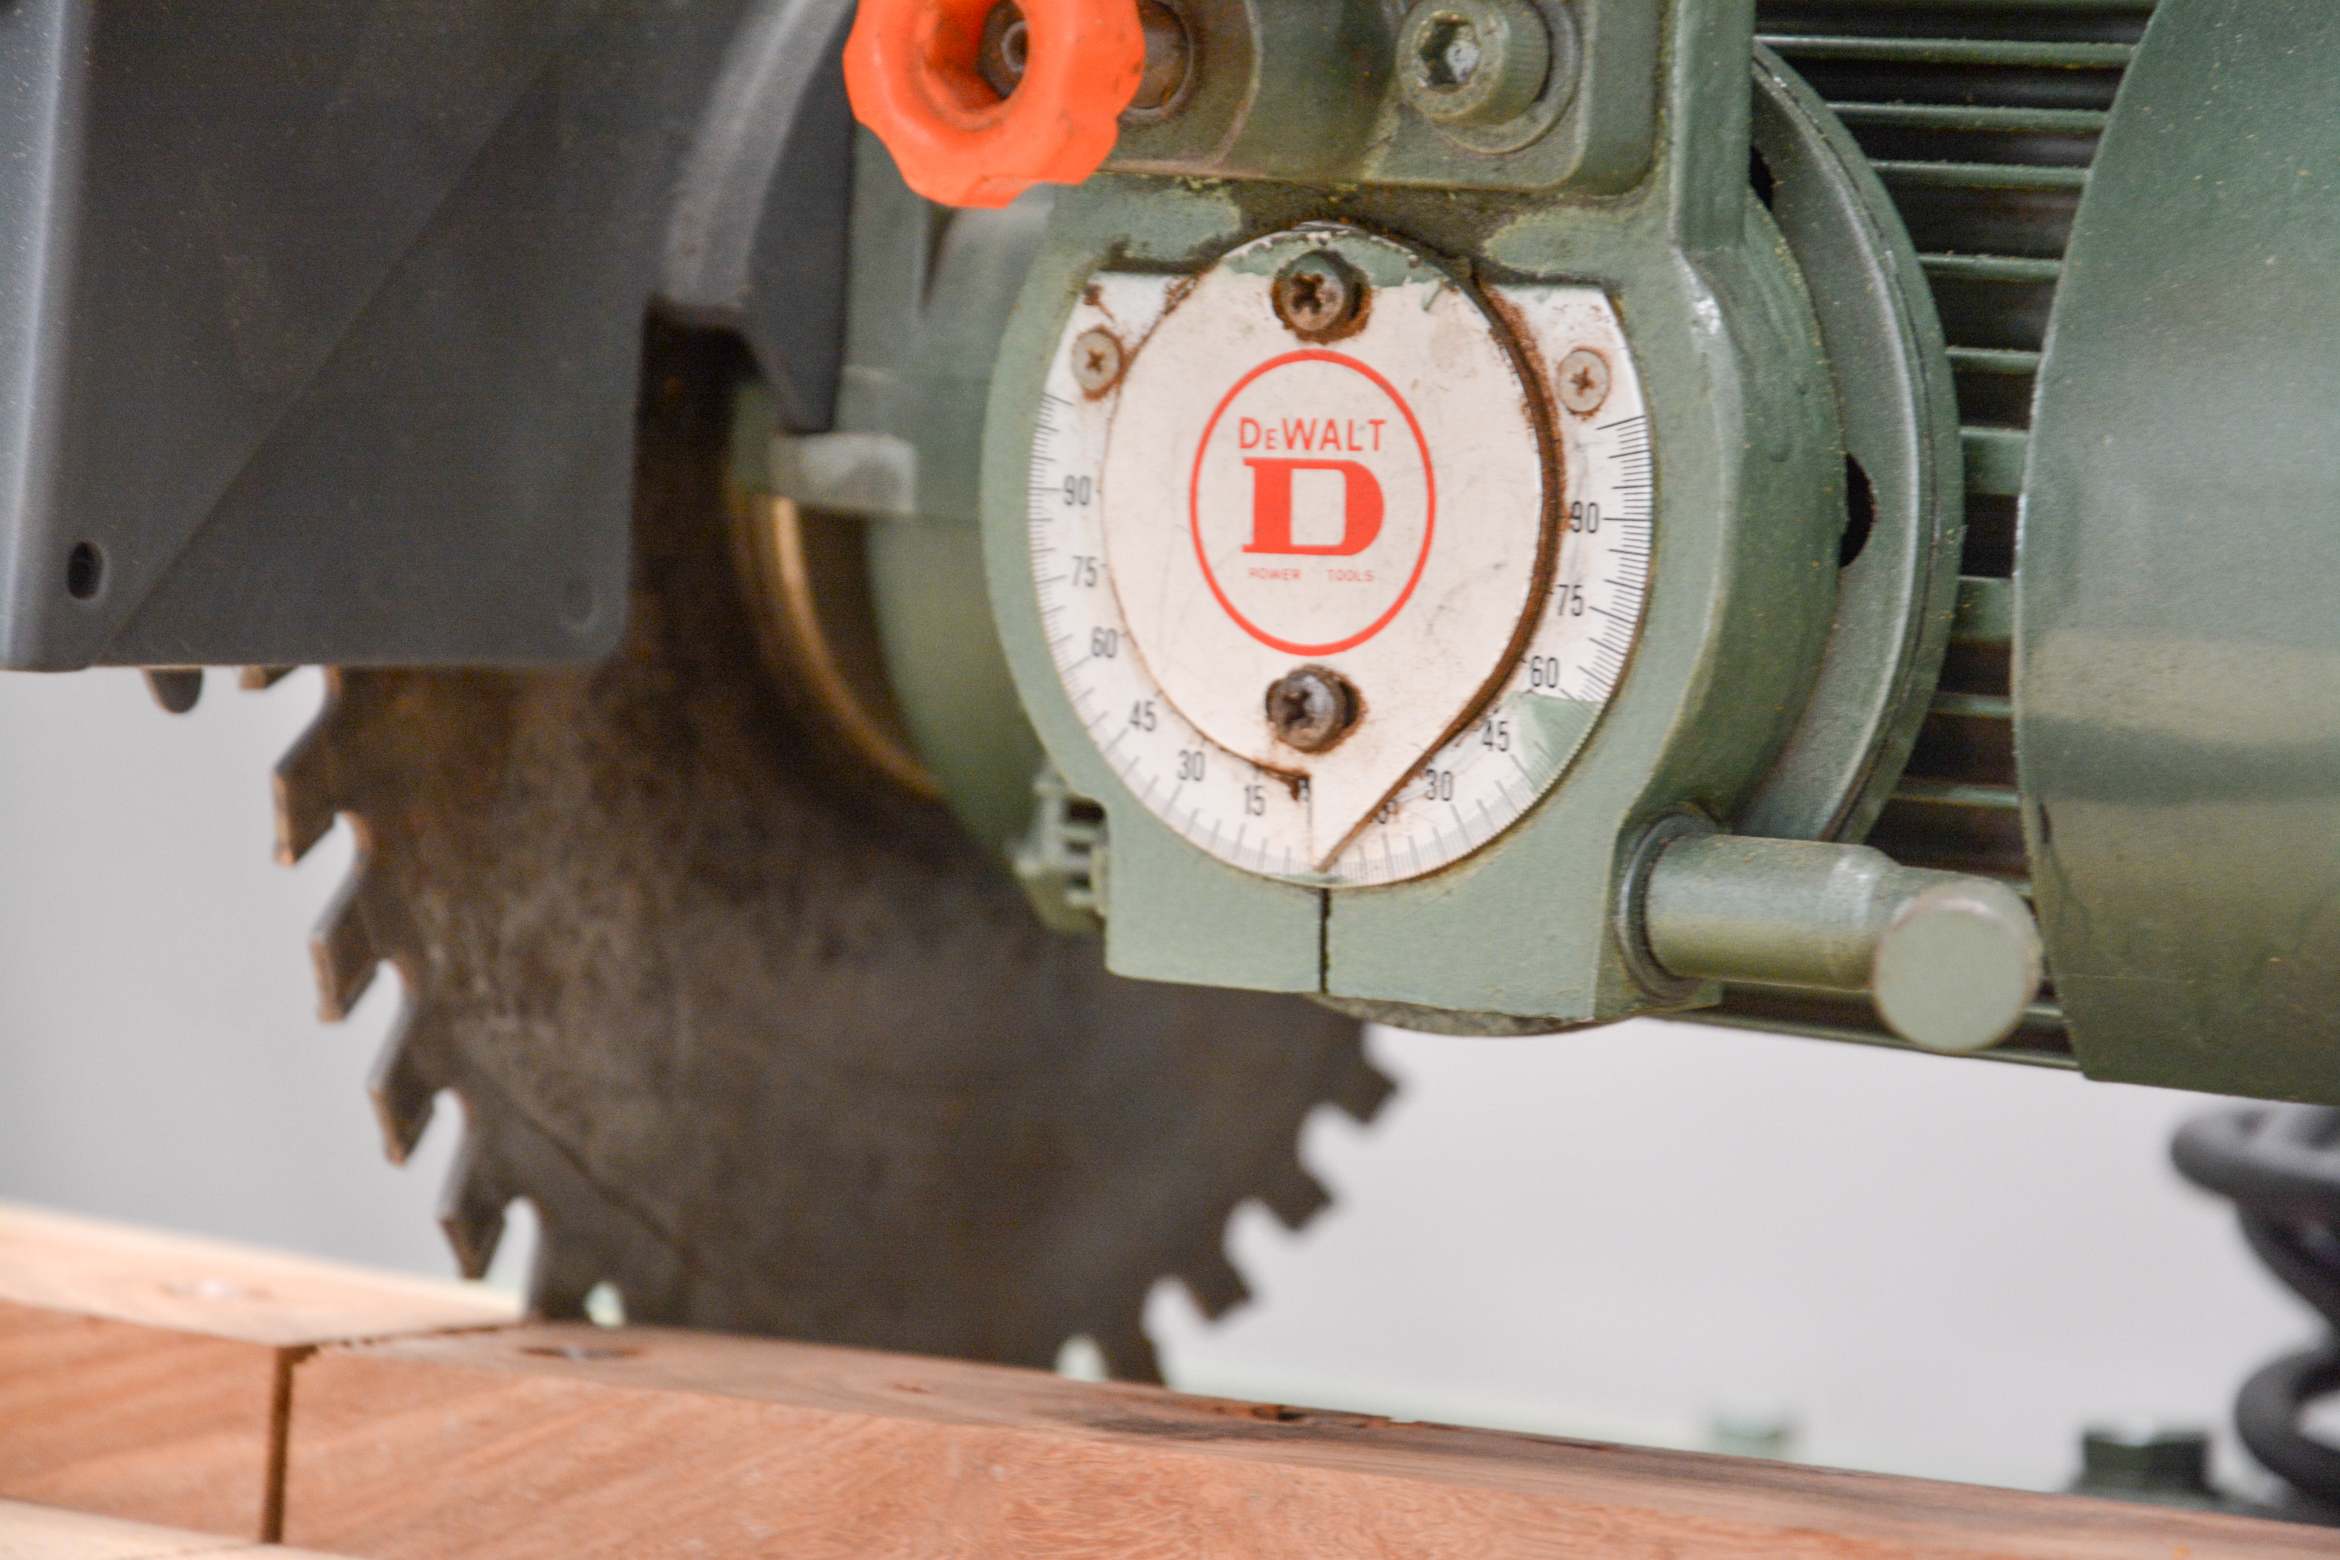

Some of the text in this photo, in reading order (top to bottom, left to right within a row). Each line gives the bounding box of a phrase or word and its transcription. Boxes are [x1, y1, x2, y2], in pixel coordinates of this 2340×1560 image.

[1064, 474, 1092, 506] 90
[1241, 457, 1385, 557] D
[1569, 500, 1600, 533] 90
[1072, 555, 1098, 588] 75
[1248, 567, 1375, 583] POWER TOOLS
[1557, 583, 1583, 616] 75
[1091, 626, 1119, 659] 60
[1530, 655, 1559, 688] 60
[1130, 699, 1158, 732] 45
[1482, 719, 1510, 752] 45
[1178, 749, 1207, 782] 30
[1244, 785, 1266, 816] 15
[1425, 768, 1454, 801] 30
